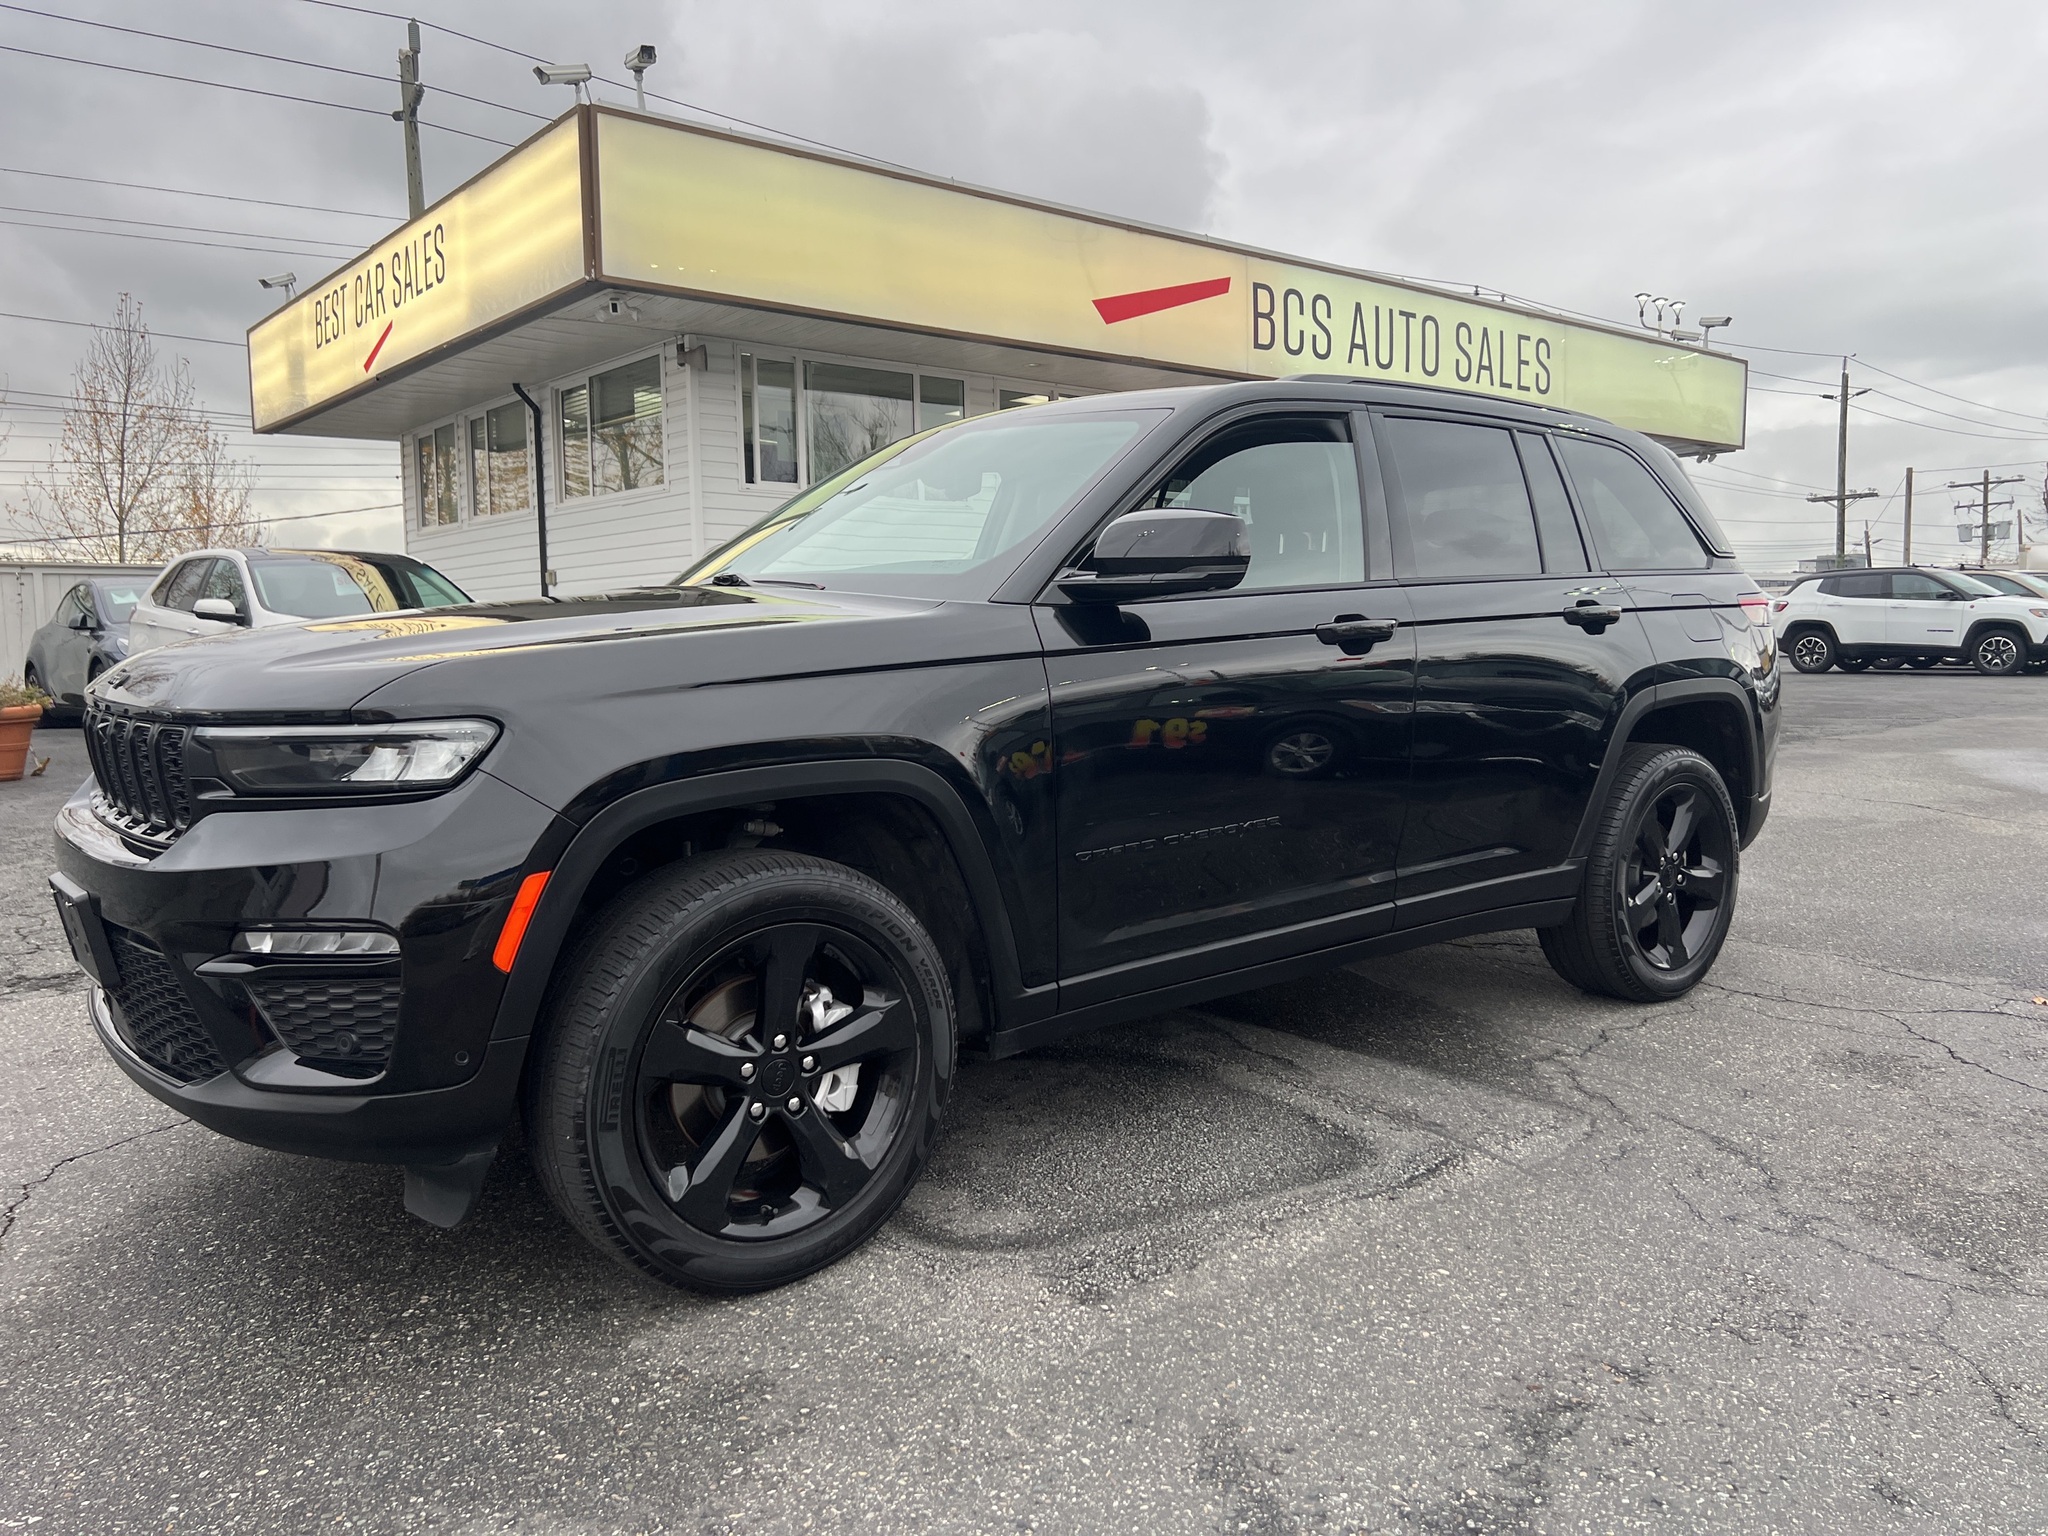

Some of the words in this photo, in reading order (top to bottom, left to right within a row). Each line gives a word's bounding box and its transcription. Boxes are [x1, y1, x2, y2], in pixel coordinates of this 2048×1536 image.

[315, 283, 347, 349] BEST
[354, 262, 386, 329] CAR
[392, 224, 445, 308] SALES
[1252, 281, 1333, 360] BCS
[1347, 301, 1440, 377] AUTO
[1455, 322, 1552, 395] SALES
[919, 957, 944, 1010] VERDE
[599, 1046, 629, 1133] PIRELLI
